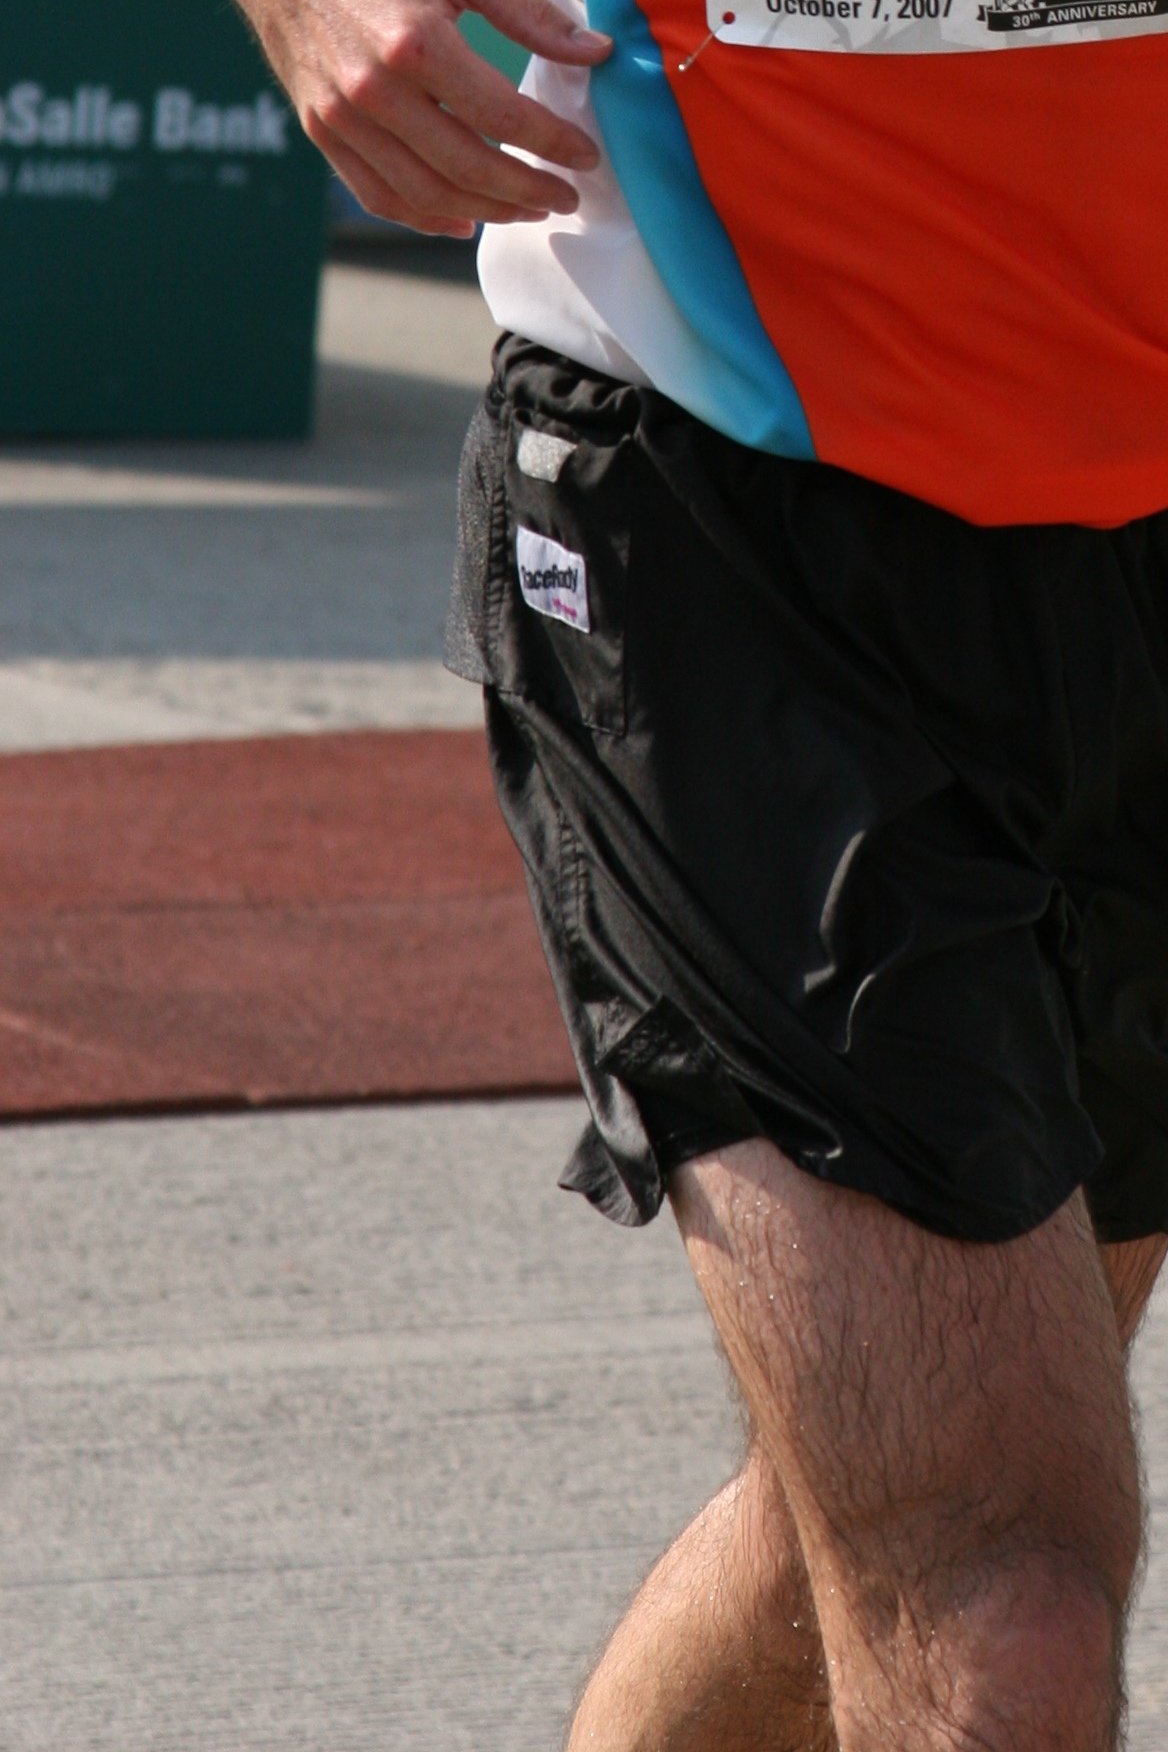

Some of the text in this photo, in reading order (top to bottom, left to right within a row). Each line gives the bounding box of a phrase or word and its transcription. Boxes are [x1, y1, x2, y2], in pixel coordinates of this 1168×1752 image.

[1012, 0, 1158, 28] 30th ANNIVERSARY
[0, 80, 289, 155] Salle Bank
